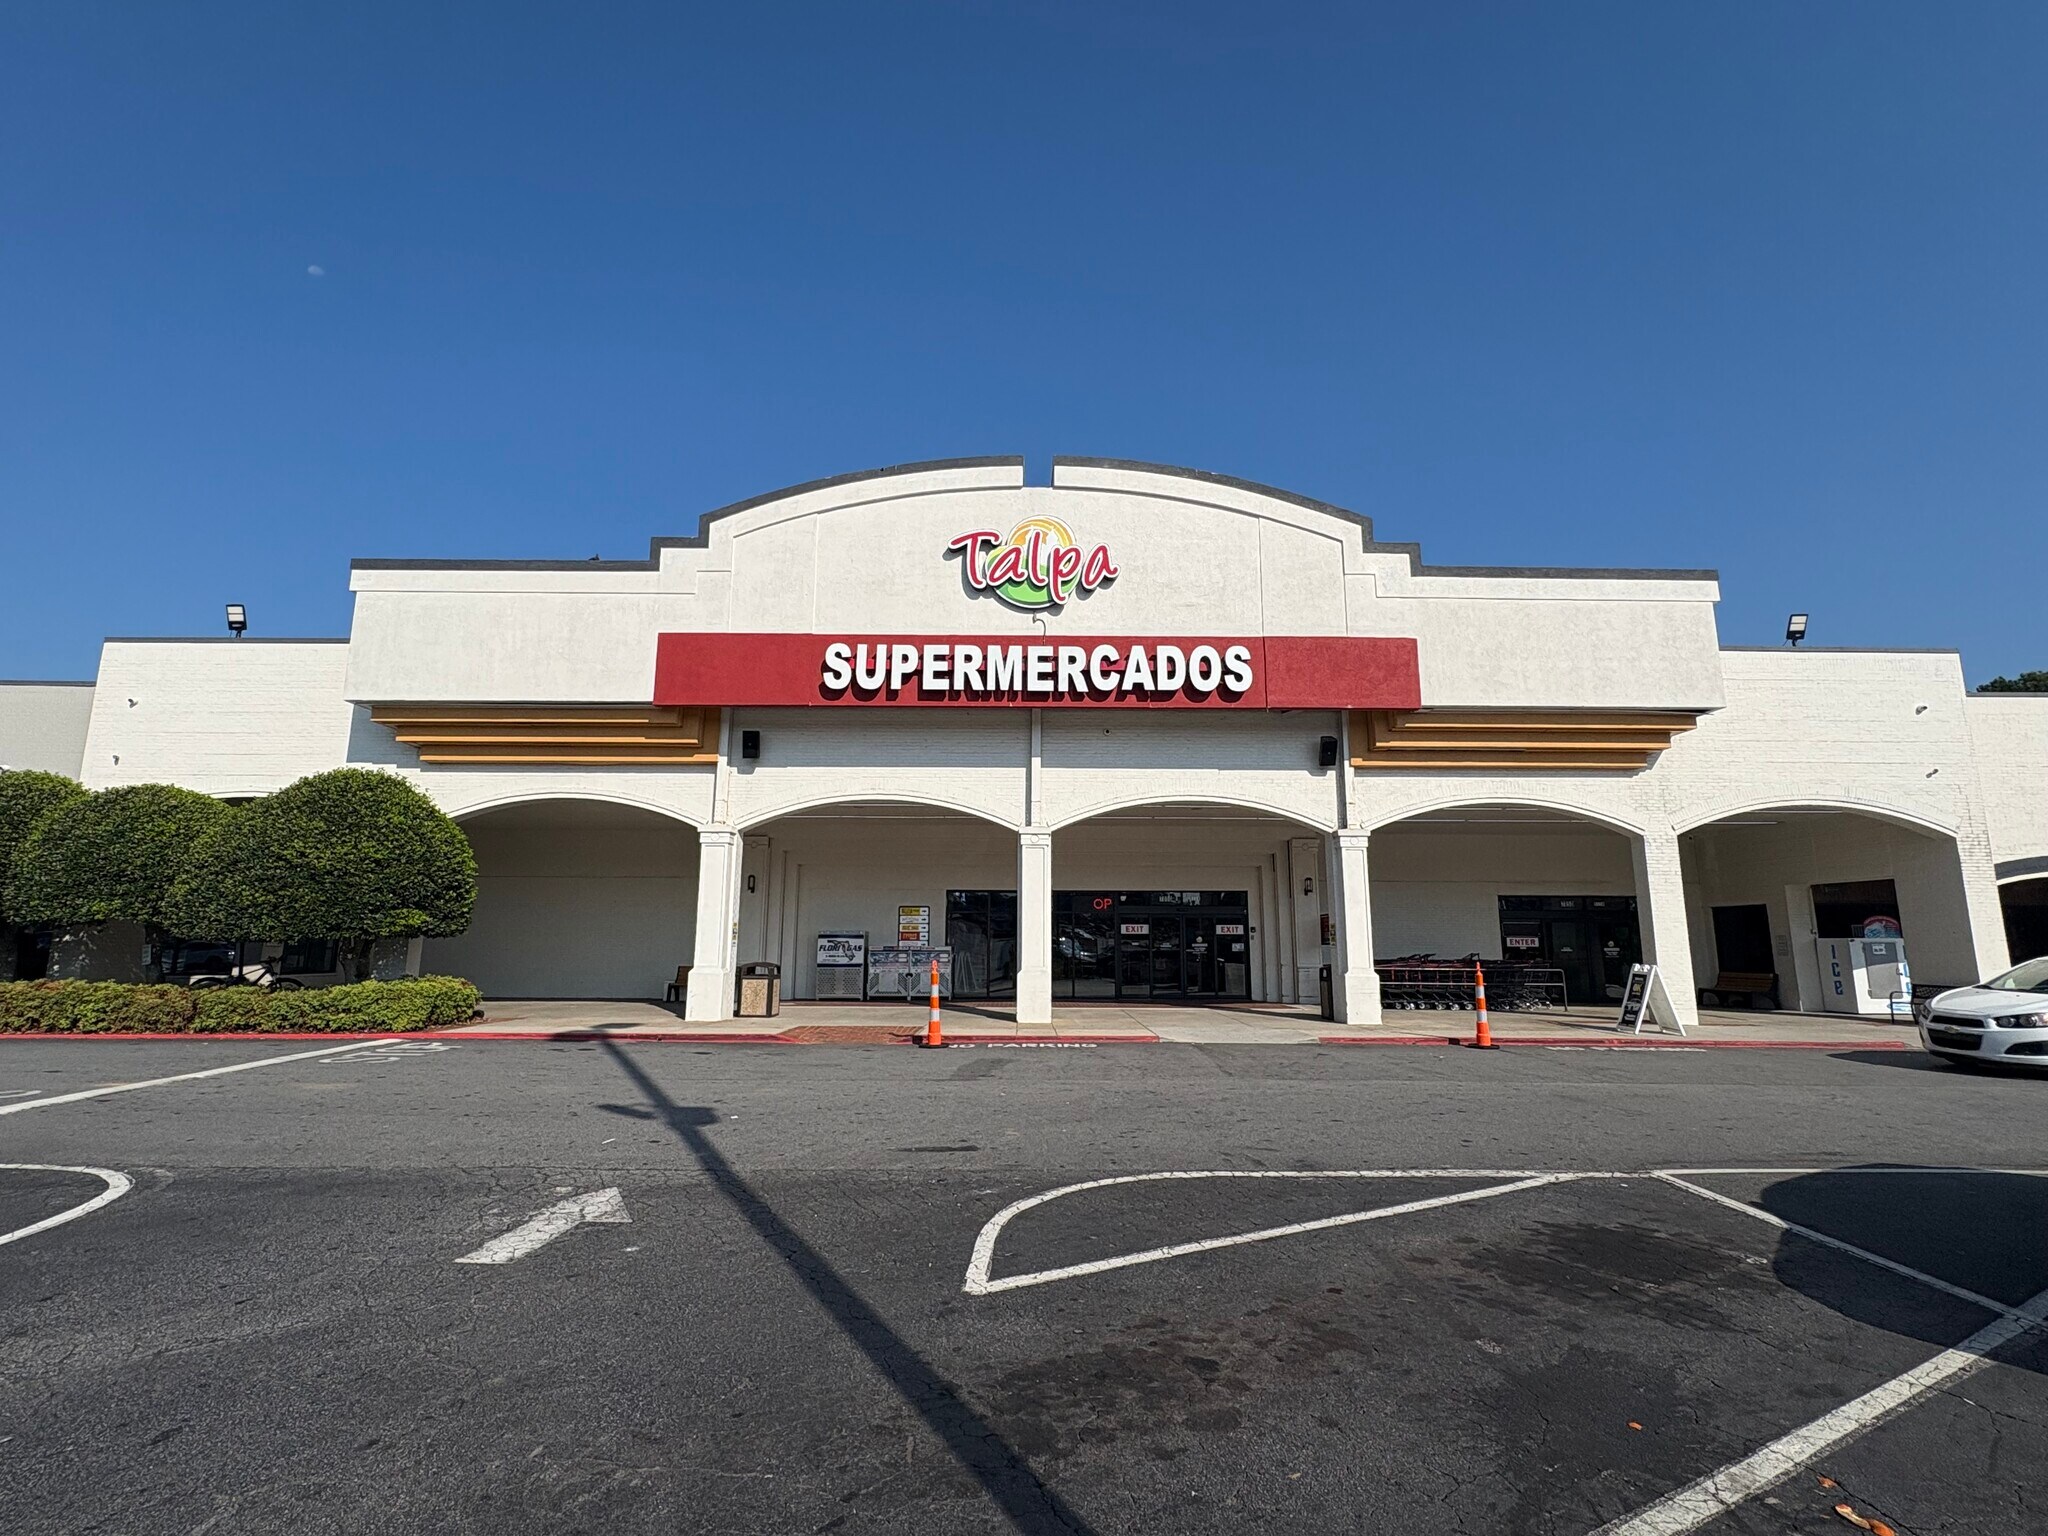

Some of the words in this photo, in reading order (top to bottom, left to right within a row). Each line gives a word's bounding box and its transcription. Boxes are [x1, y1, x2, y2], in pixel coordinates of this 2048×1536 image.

[946, 528, 1121, 606] Talpa
[822, 643, 1253, 693] SUPERMERCADOS
[1125, 925, 1144, 933] EXIT
[1220, 926, 1239, 934] EXIT
[1509, 938, 1536, 946] ENTER
